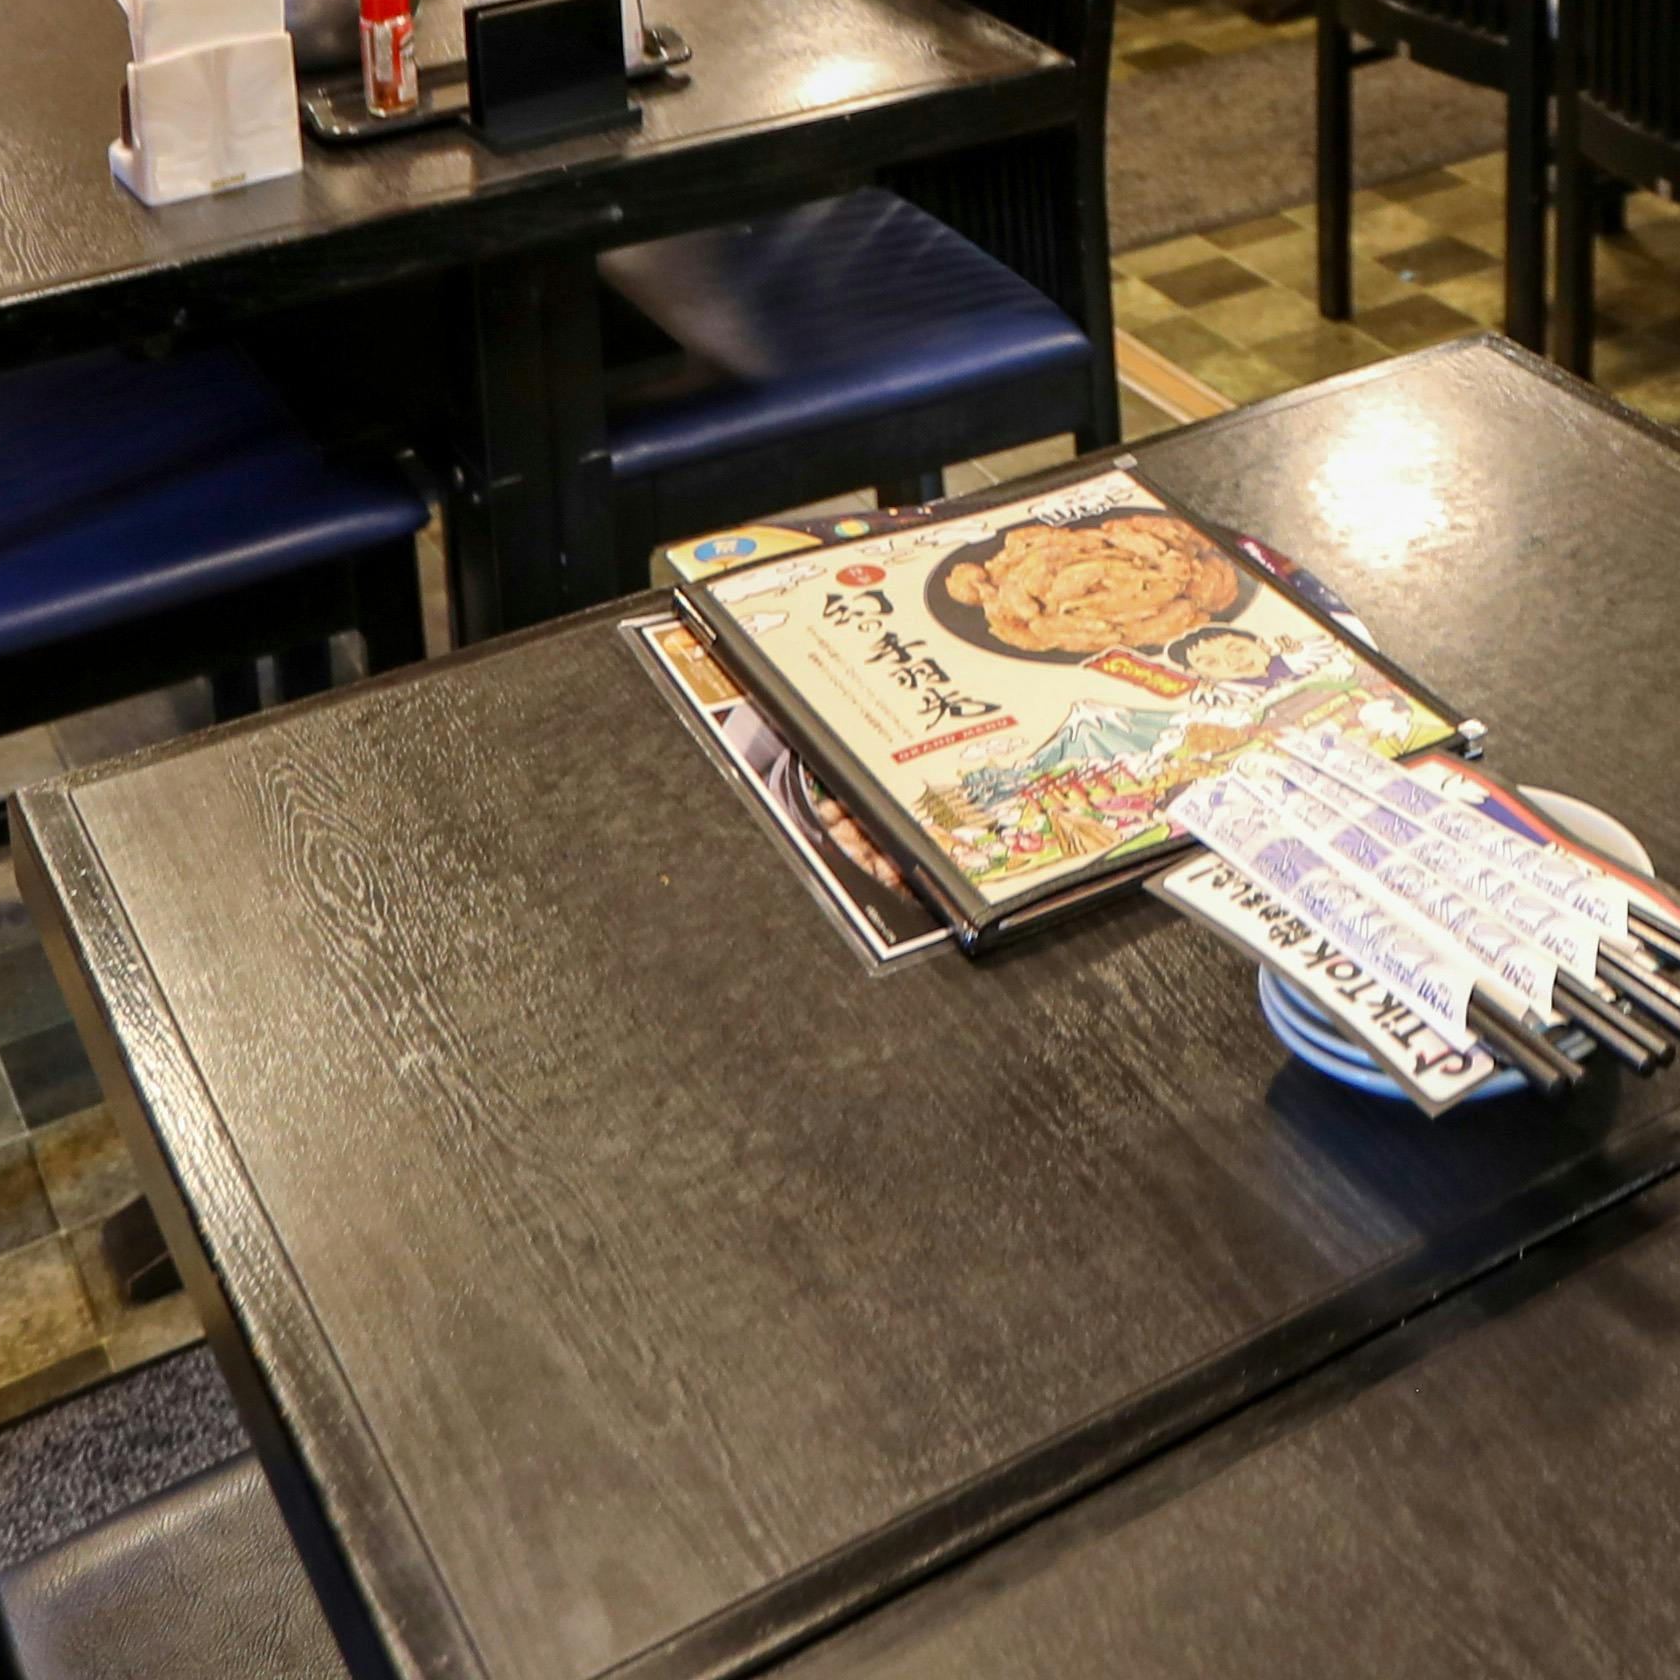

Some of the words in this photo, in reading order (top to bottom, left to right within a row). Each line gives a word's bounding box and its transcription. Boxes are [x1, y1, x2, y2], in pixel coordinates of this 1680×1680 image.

[823, 590, 1002, 731] 幻の手羽先
